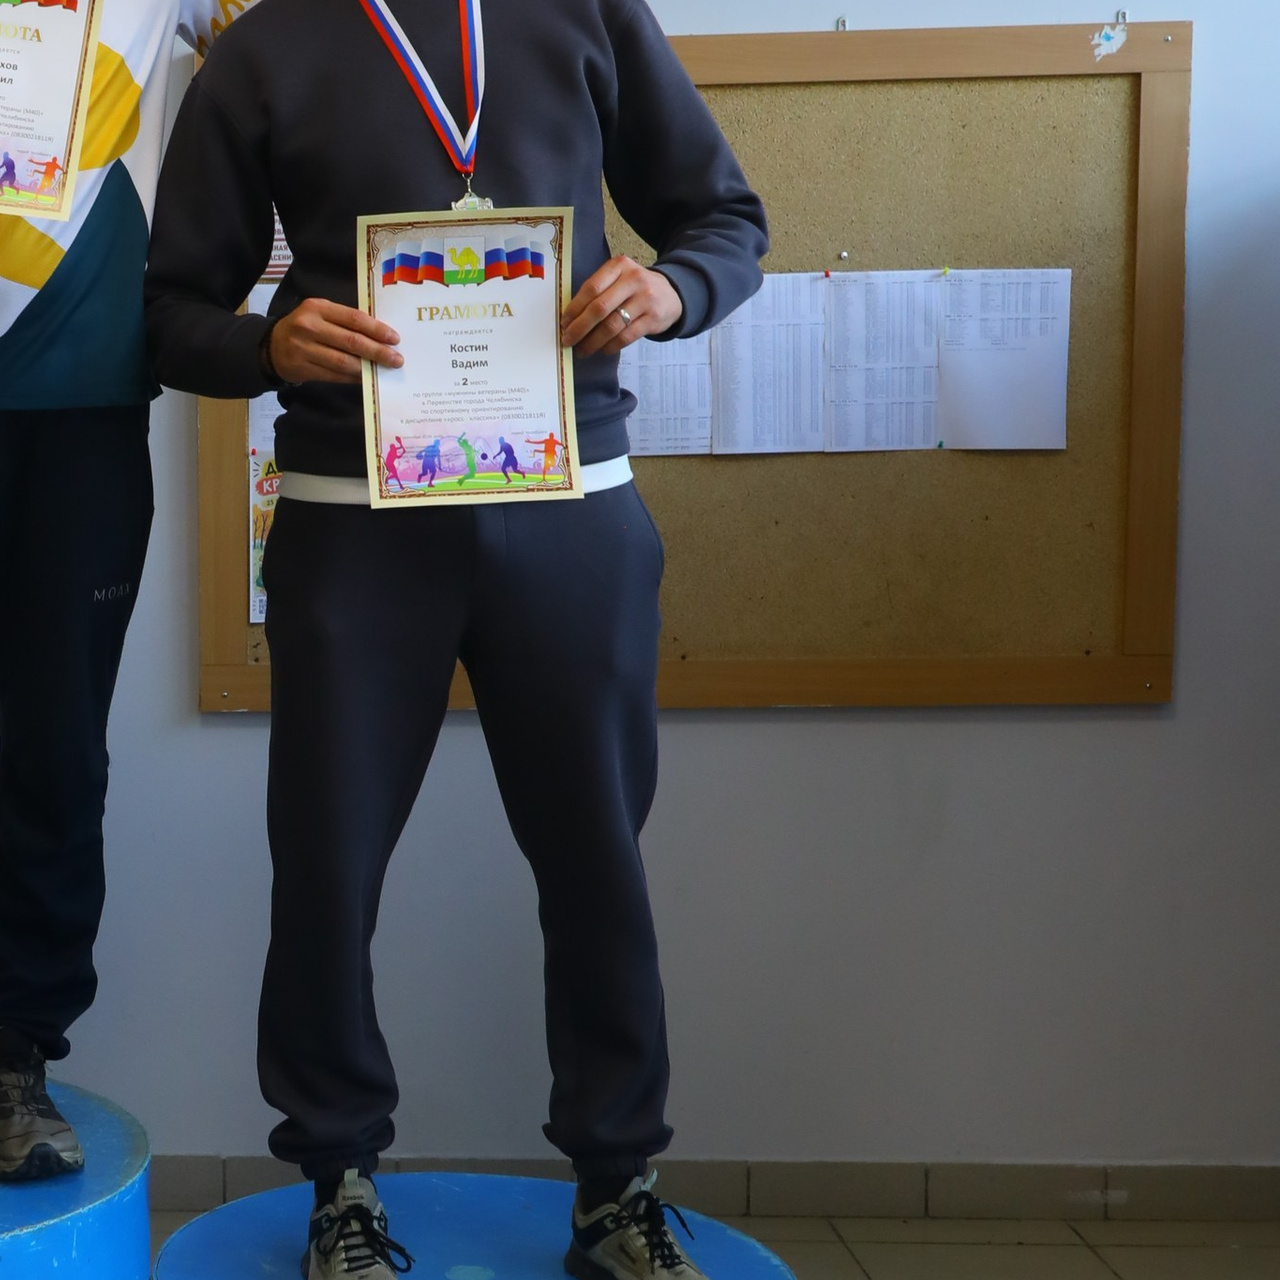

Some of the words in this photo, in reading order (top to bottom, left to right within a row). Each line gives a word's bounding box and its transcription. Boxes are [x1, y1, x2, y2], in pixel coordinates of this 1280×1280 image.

[416, 302, 514, 322] ГРАМОТА
[443, 328, 494, 336] награждается
[450, 343, 489, 353] Костин
[451, 359, 489, 370] Вадим
[461, 377, 469, 386] 2
[263, 479, 280, 494] КР
